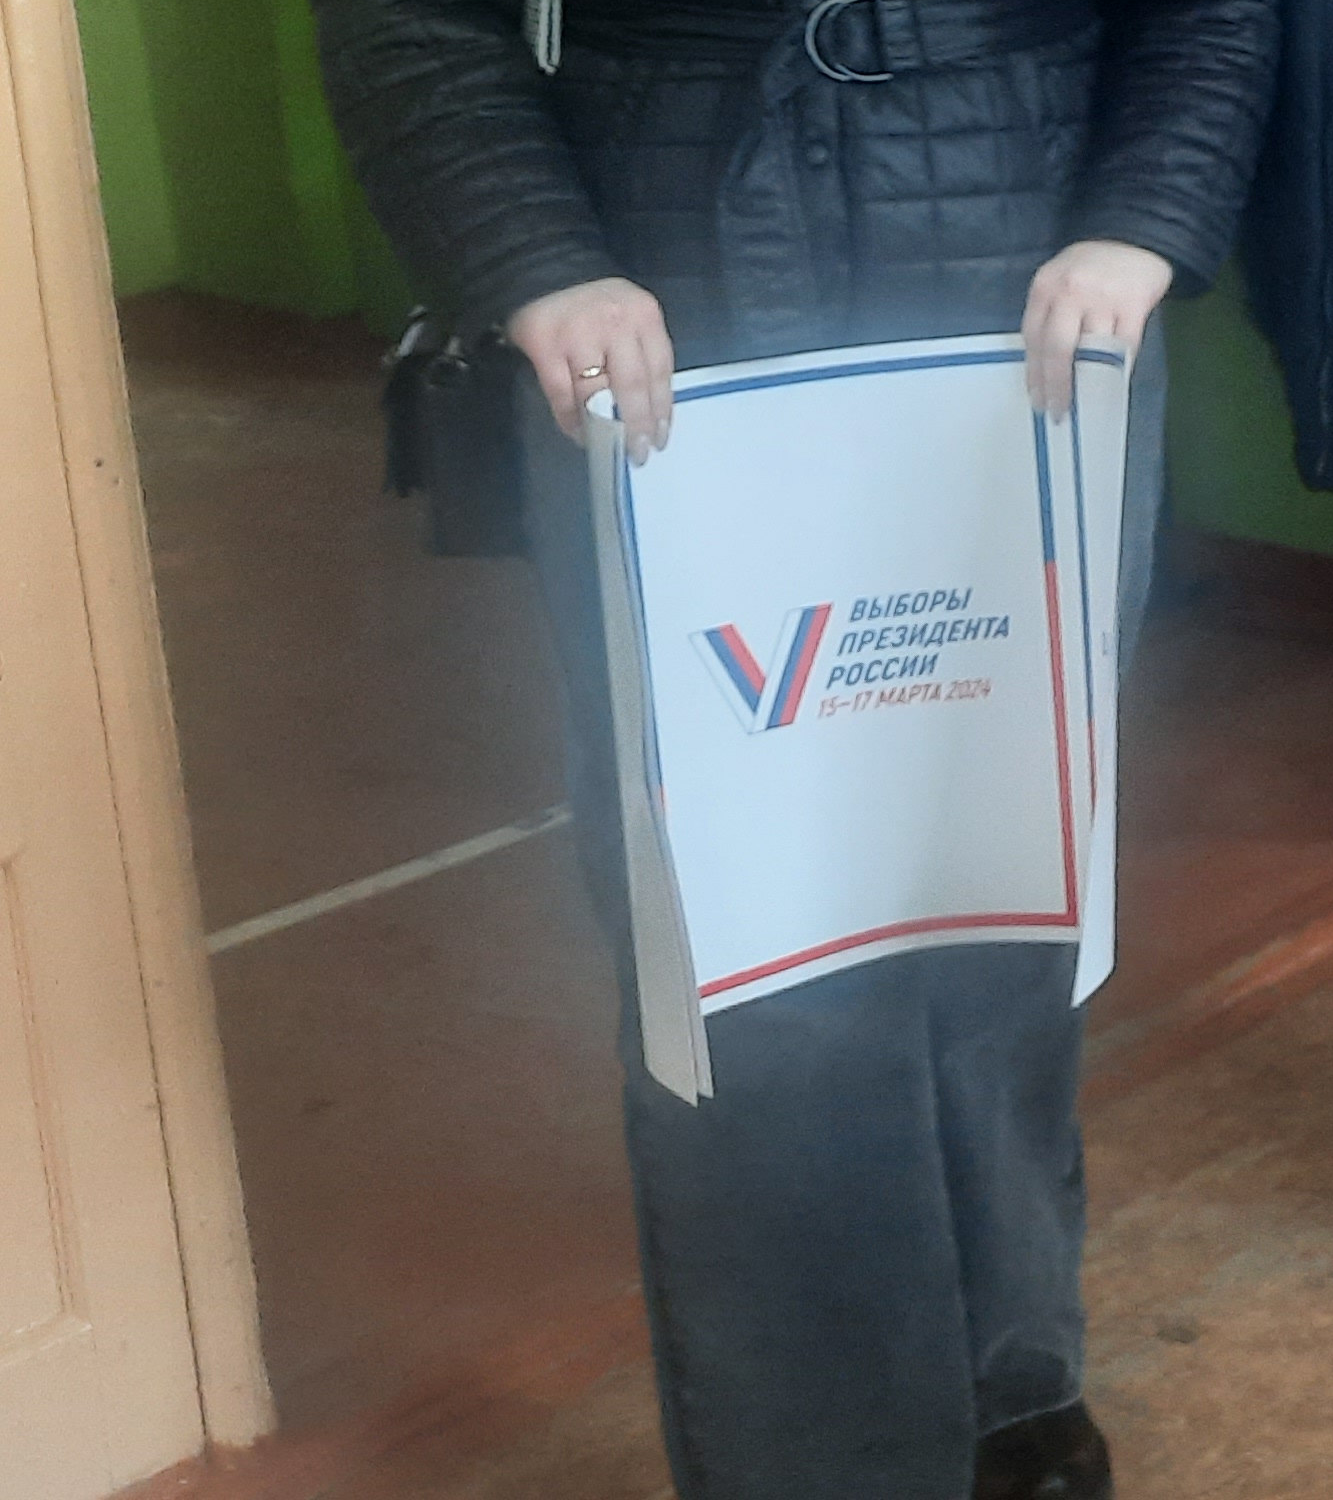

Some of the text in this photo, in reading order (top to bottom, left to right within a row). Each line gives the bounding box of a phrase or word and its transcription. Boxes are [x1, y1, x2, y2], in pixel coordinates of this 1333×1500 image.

[850, 587, 973, 623] ВЫБОРЫ
[836, 615, 1009, 657] ПРЕЗИДЕНТА
[826, 652, 940, 690] РОССИИ
[875, 681, 942, 711] МАРТА
[945, 677, 992, 702] 2024
